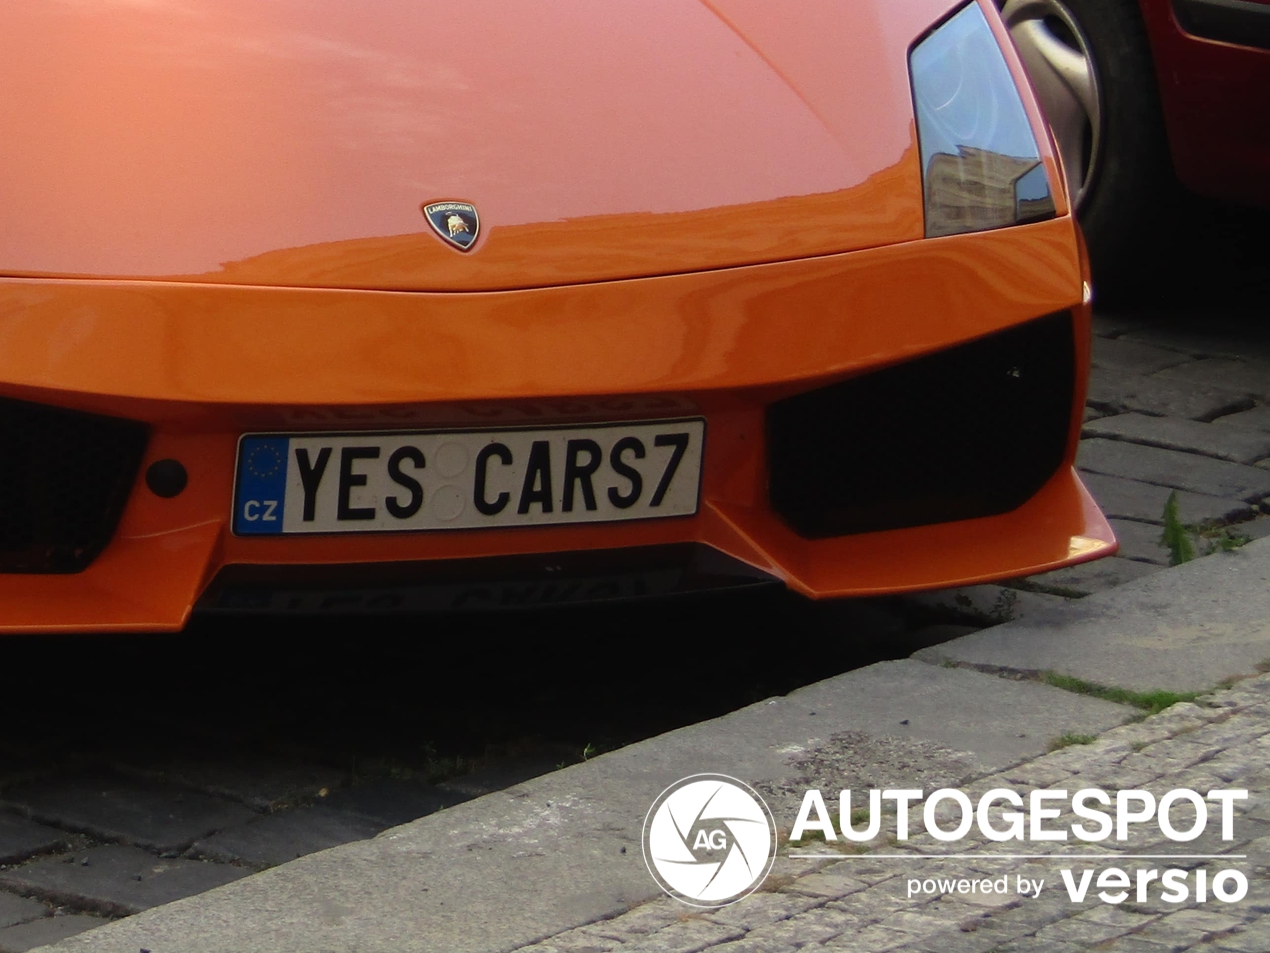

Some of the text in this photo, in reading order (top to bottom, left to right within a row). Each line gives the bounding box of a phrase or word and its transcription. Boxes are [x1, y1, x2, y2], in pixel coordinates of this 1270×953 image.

[428, 204, 473, 214] LAMBORGHINI
[295, 432, 690, 522] YES CARS7
[243, 499, 278, 522] CZ
